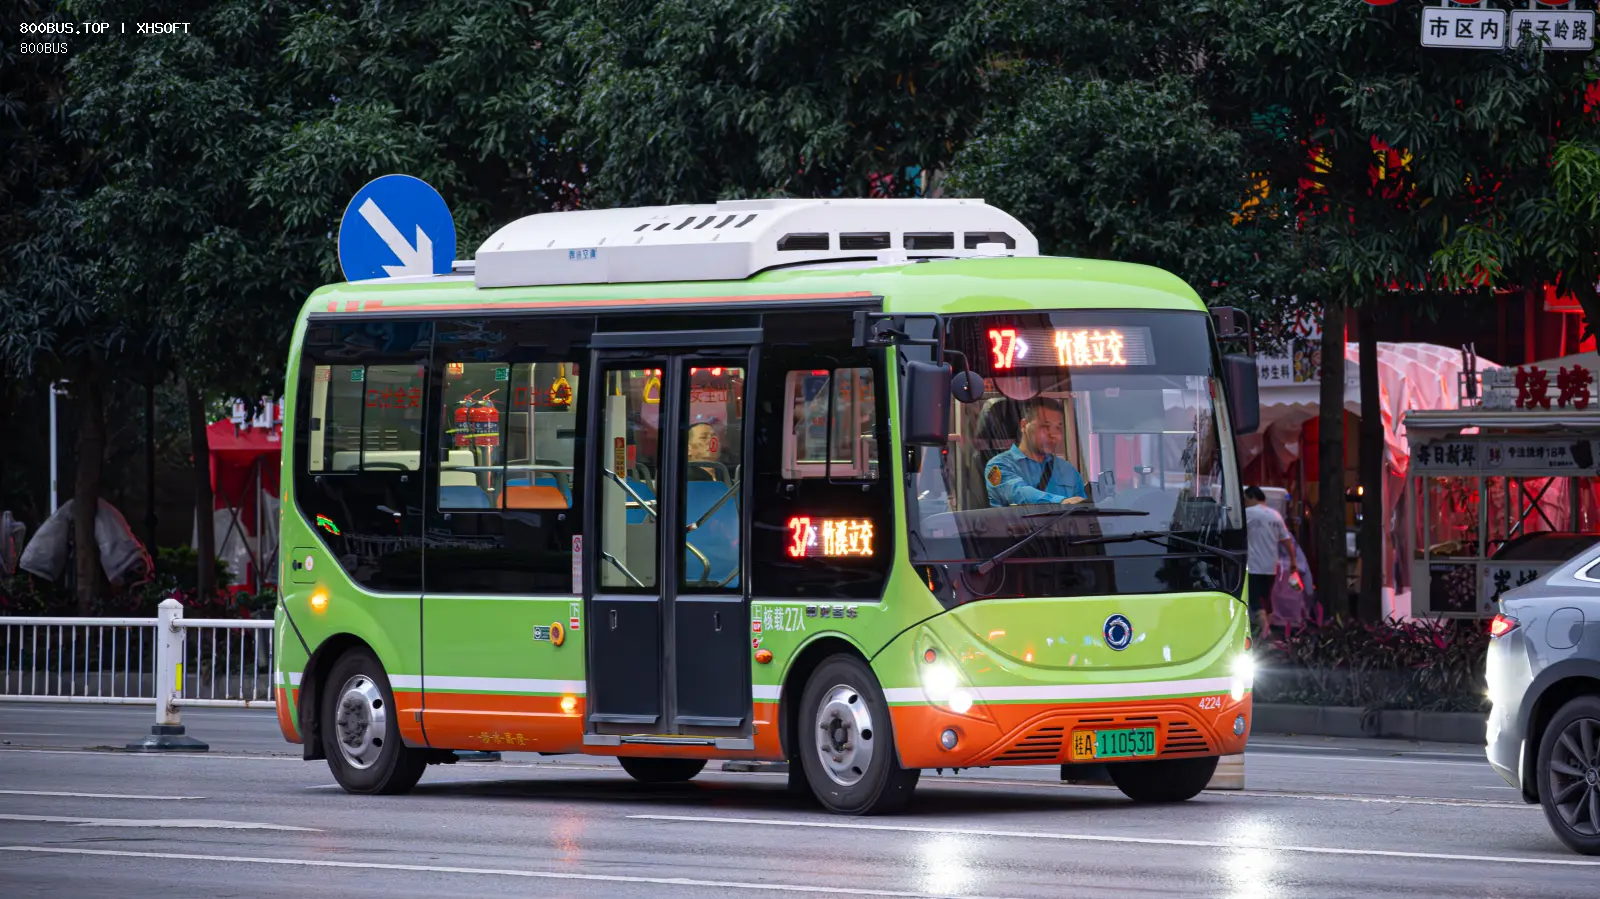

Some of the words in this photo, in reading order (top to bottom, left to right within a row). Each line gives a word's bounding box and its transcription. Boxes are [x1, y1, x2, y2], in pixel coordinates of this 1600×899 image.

[1429, 17, 1498, 40] 市区内
[1518, 19, 1587, 41] 佛子岭路
[989, 329, 1016, 369] 37
[1055, 330, 1127, 366] 竹溪立交
[788, 516, 811, 557] 37
[822, 519, 874, 556] 竹溪立交
[763, 606, 806, 632] 核载27人
[1198, 696, 1222, 710] 4224
